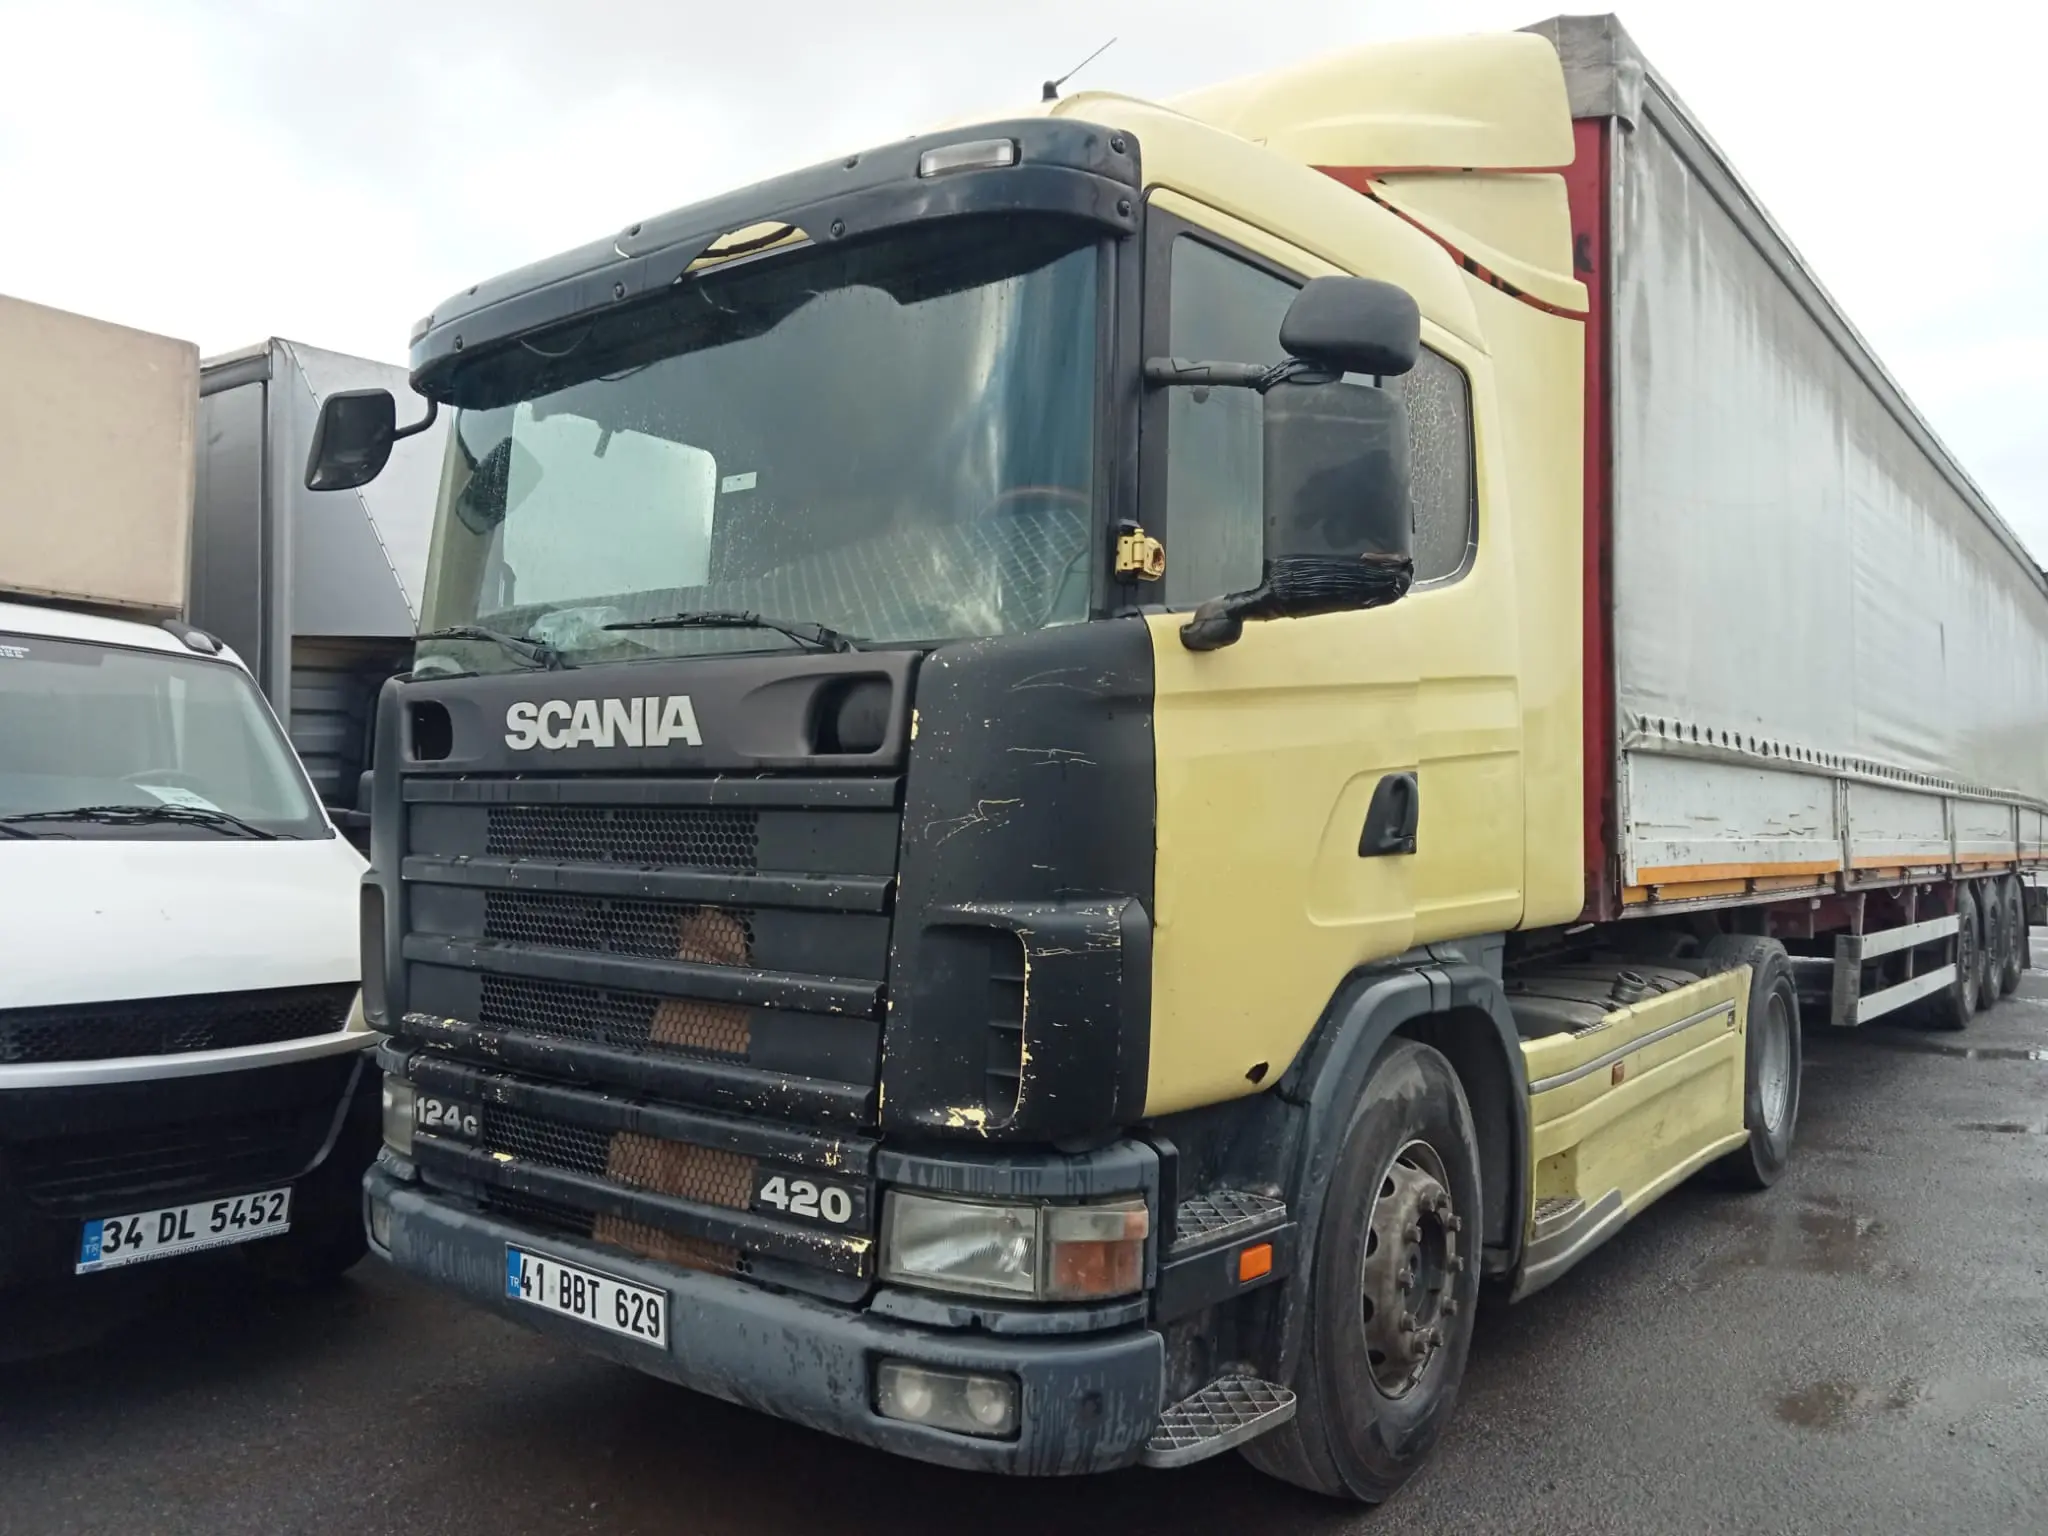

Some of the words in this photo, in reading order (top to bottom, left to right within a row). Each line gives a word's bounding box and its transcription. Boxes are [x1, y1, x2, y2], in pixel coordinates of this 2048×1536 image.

[504, 695, 703, 750] SCANIA
[102, 1216, 144, 1253] 34
[157, 1208, 195, 1244] DL
[210, 1192, 285, 1233] 5452
[760, 1176, 852, 1224] 420
[510, 1275, 521, 1289] TR
[520, 1258, 544, 1301] 41
[559, 1269, 600, 1319] BBT
[615, 1288, 660, 1338] 629
